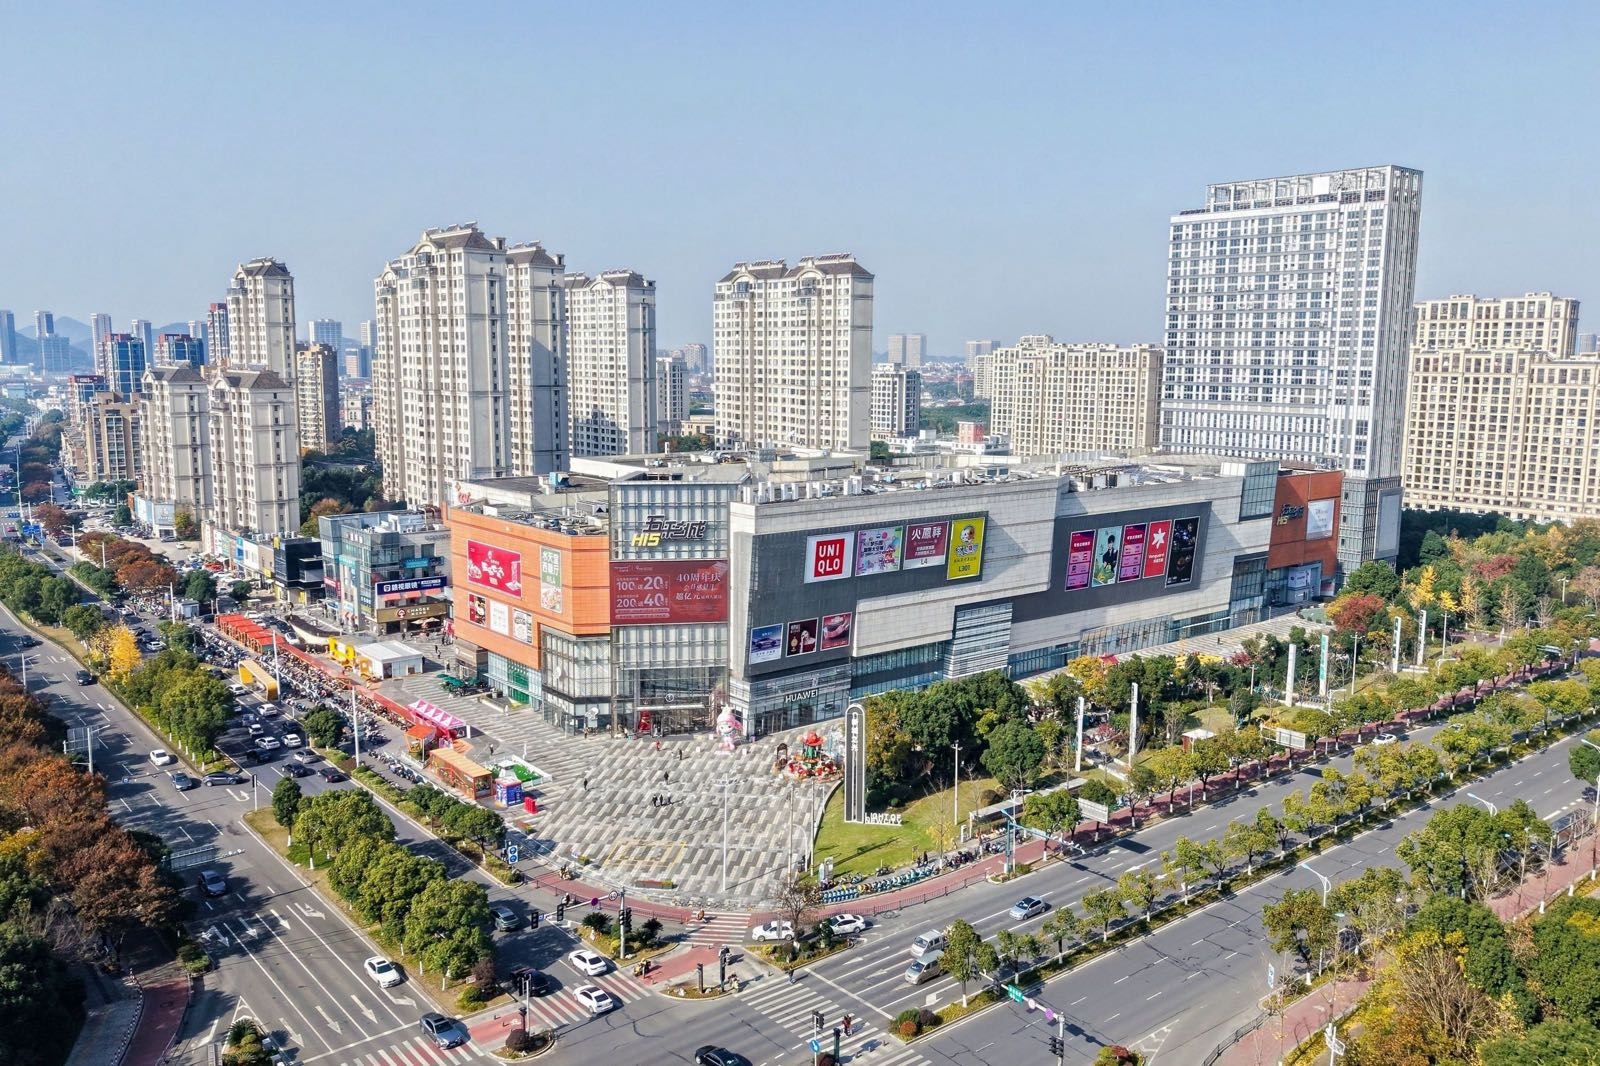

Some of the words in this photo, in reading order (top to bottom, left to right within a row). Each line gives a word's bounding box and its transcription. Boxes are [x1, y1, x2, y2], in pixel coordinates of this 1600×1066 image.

[818, 544, 840, 558] UNI
[817, 559, 841, 575] QLO
[616, 581, 635, 591] 100
[643, 576, 664, 590] 20
[616, 598, 637, 608] 200
[643, 593, 665, 607] 40
[785, 689, 818, 703] HUAWEI
